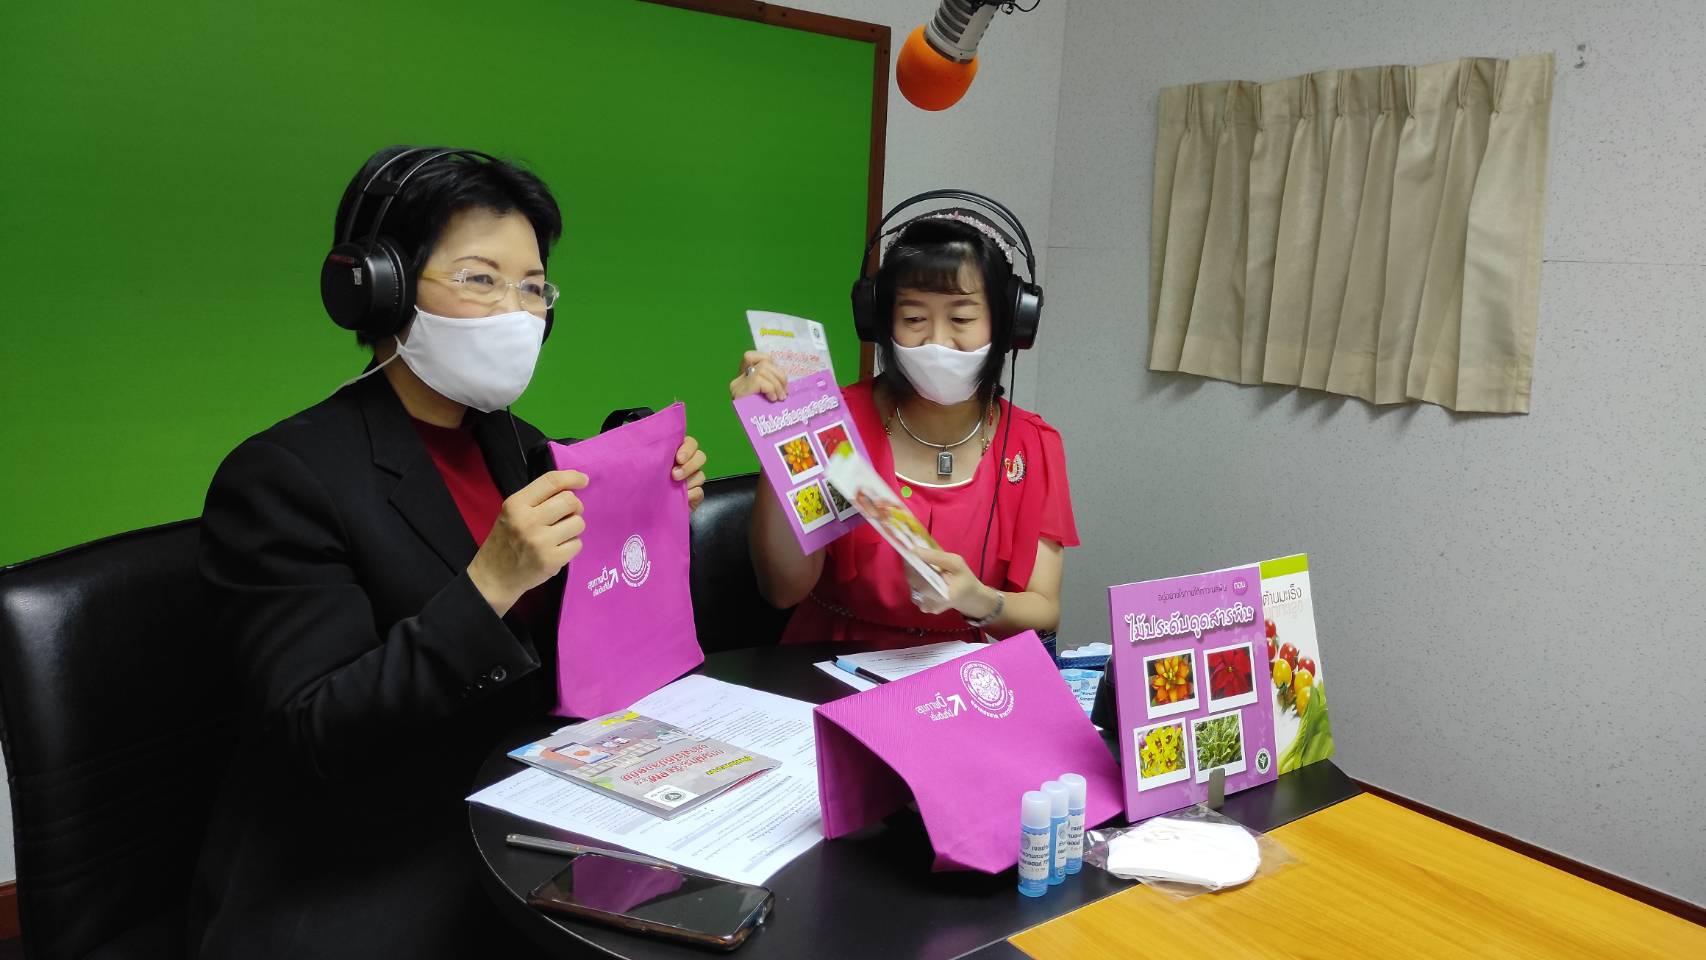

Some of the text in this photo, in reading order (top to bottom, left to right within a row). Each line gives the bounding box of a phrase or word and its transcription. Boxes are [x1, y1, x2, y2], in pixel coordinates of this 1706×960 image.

[1125, 602, 1255, 642] ไม้ประดับดูดสารพิษ
